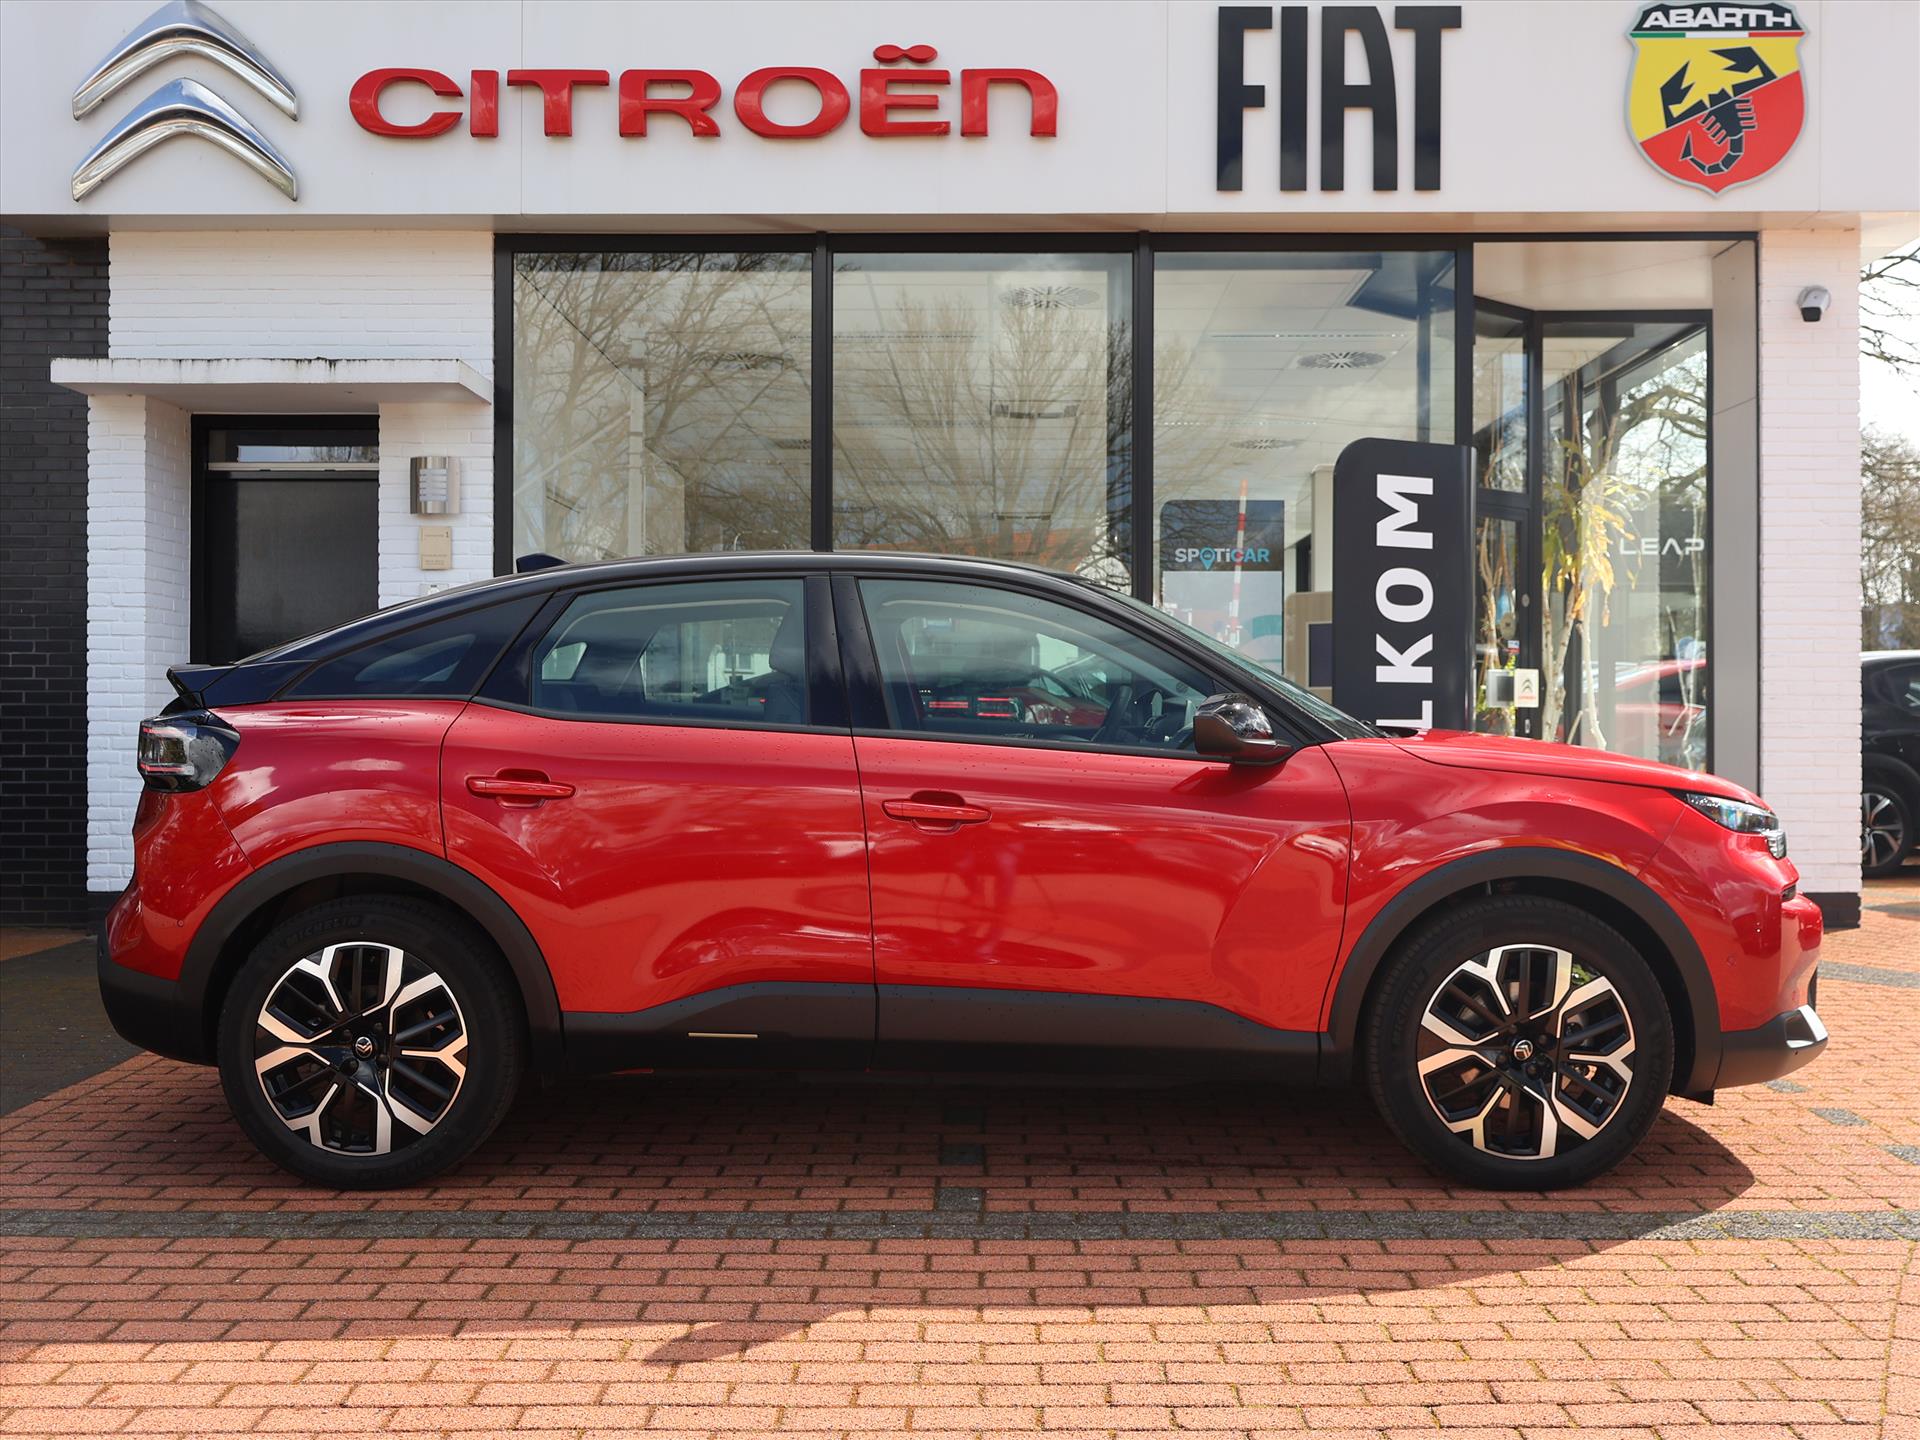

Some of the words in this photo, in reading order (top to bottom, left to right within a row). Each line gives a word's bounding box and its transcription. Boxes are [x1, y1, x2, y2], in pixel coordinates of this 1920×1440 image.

[1642, 7, 1792, 28] ABARTH
[349, 44, 1058, 138] CITROËN
[1217, 6, 1462, 191] FIAT
[1619, 537, 1705, 556] LEAP
